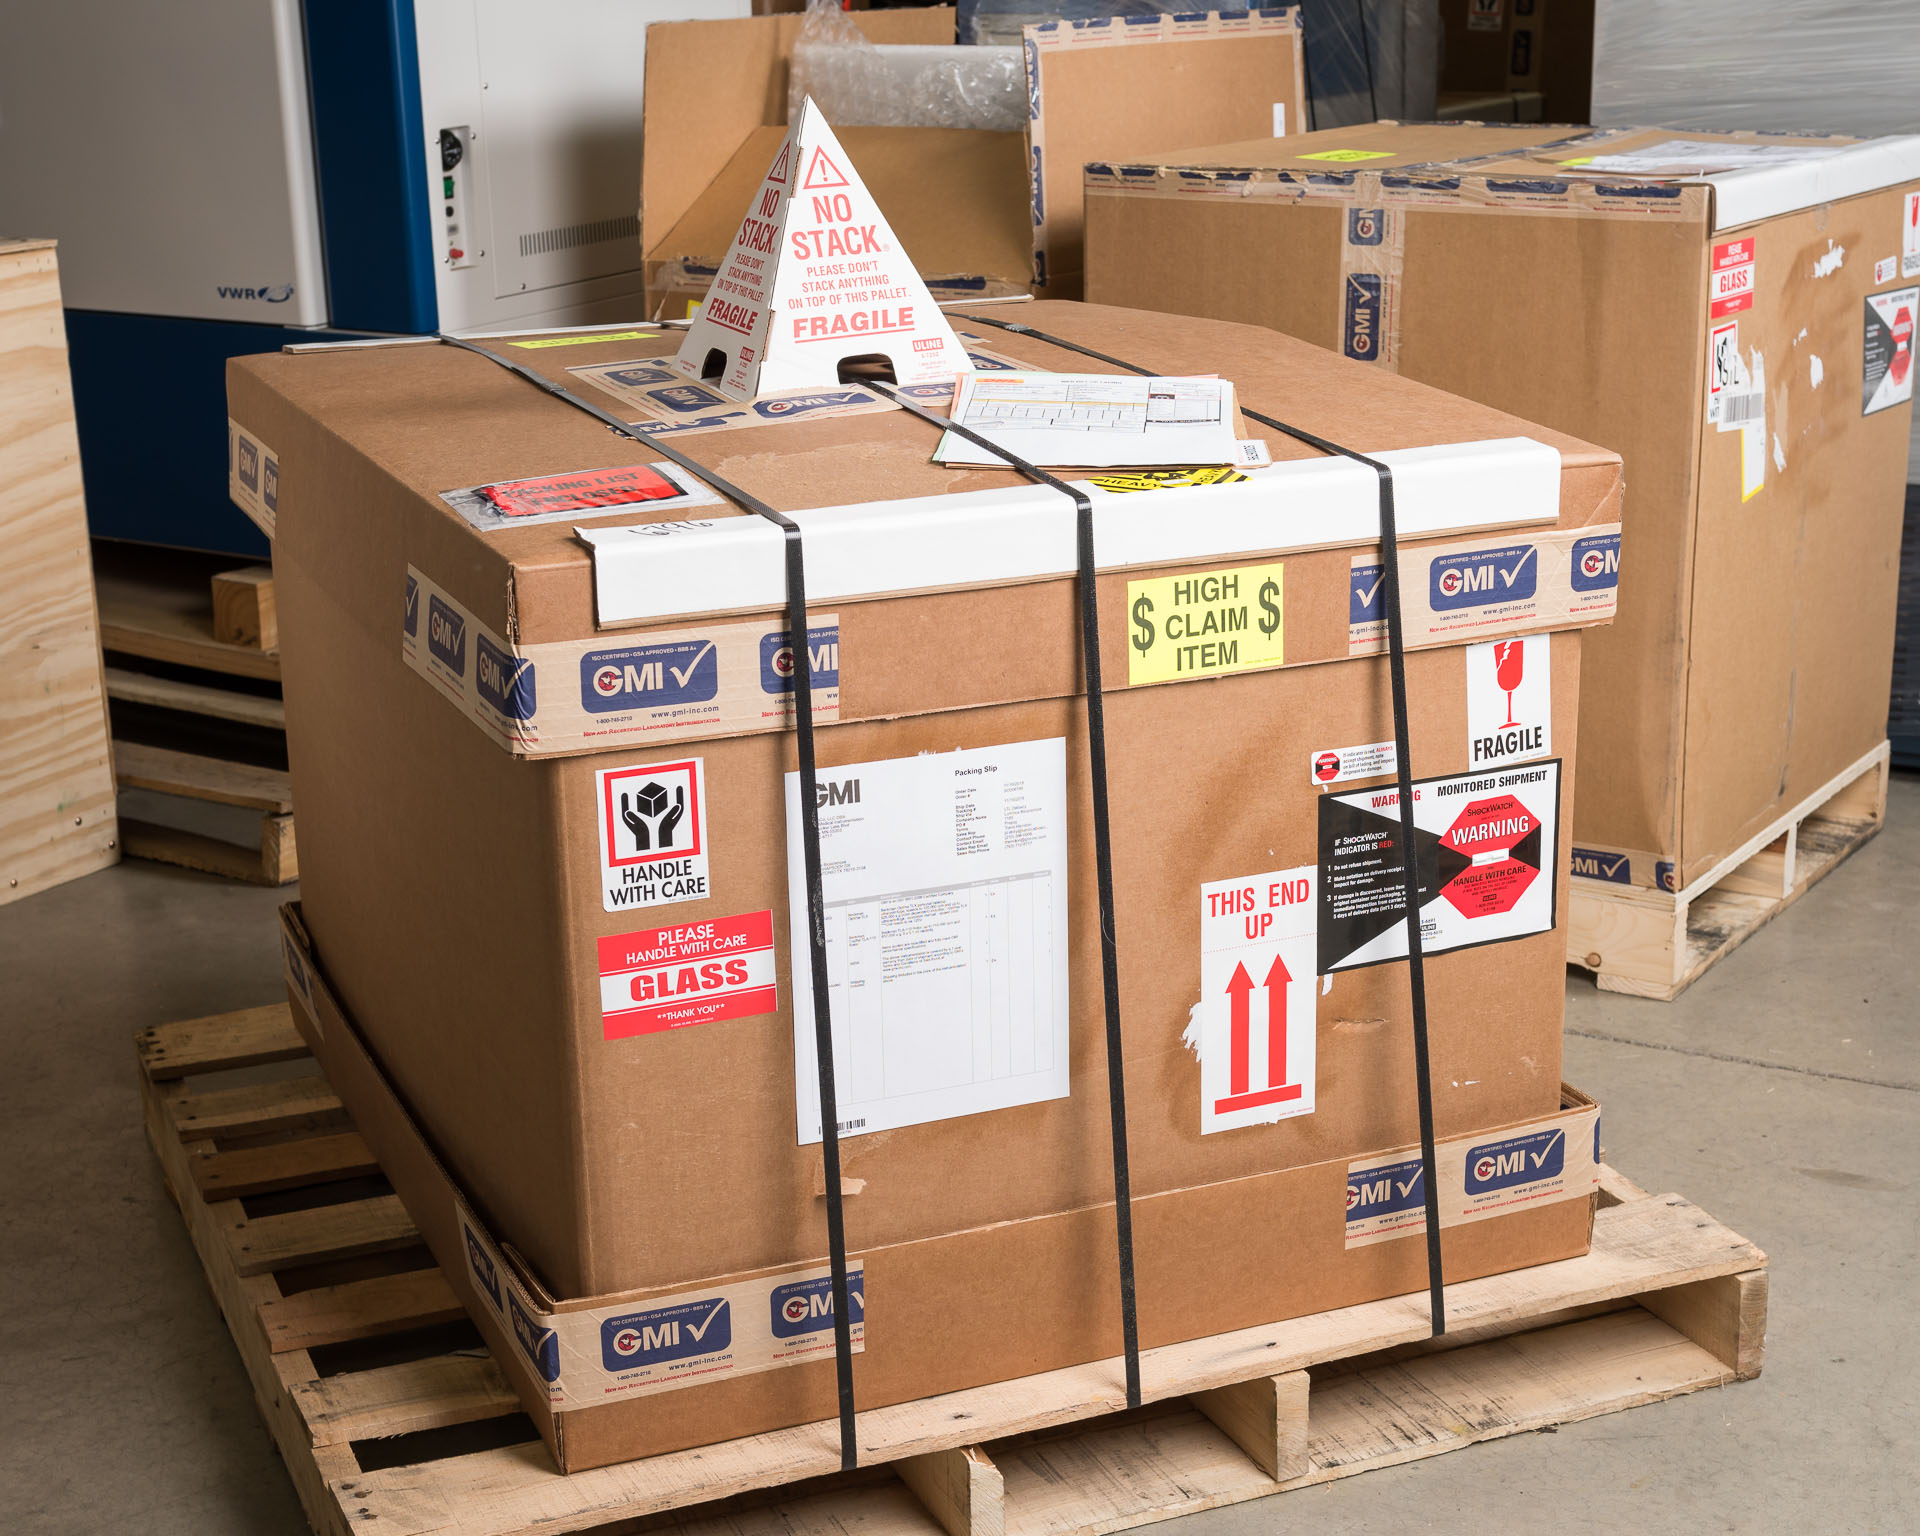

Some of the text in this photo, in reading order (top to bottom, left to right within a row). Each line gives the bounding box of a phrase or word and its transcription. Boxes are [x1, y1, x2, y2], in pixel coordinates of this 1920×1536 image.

[759, 188, 780, 218] NO
[812, 194, 852, 224] NO
[738, 218, 778, 253] STACK
[791, 225, 882, 260] STACK
[735, 253, 751, 268] PLEASE
[807, 261, 878, 277] PLEASE DON'T
[218, 286, 256, 300] VWR
[802, 274, 889, 293] STACK ANYTHING
[1720, 270, 1747, 293] GLASS
[789, 288, 911, 309] ON TOP OF THIS PALLET.
[707, 297, 758, 331] FRAGILE
[793, 307, 914, 338] FRAGILE
[914, 339, 942, 350] ULINE
[1353, 308, 1371, 353] GMI
[767, 397, 830, 413] GMI
[594, 472, 639, 485] LIST
[1103, 478, 1160, 487] HEAVY
[1175, 575, 1238, 606] HIGH
[1439, 565, 1494, 597] GMI
[432, 611, 452, 650] GMI
[1132, 577, 1280, 658] $ CLAIM $
[602, 652, 629, 660] CERTIFIED
[1177, 640, 1238, 671] ITEM
[480, 651, 500, 694] GMI
[593, 662, 663, 696] GMI
[651, 706, 719, 718] www.gmi-inc.com
[1474, 726, 1542, 762] FRAGILE
[955, 765, 997, 776] Packing Slip
[1437, 771, 1547, 797] MONITORED SHIPMENT
[816, 779, 860, 808] GMI
[1452, 815, 1529, 846] WARNING
[1335, 844, 1370, 856] INDICATOR
[622, 859, 692, 884] HANDLE
[1453, 874, 1483, 886] HANDLE
[1485, 869, 1505, 880] WITH
[1507, 865, 1527, 876] CARE
[610, 877, 706, 906] WITH CARE
[1207, 879, 1310, 918] THIS END
[658, 924, 714, 946] PLEASE
[1245, 913, 1273, 940] UP
[626, 934, 747, 964] HANDLE WITH CARE
[629, 958, 748, 1002] GLASS
[1474, 1150, 1525, 1182] GMI
[1346, 1179, 1391, 1210] GMI
[621, 1315, 647, 1325] CERTIFIED
[663, 1308, 690, 1318] APPROVED
[613, 1321, 680, 1356] GMI
[629, 1379, 659, 1389] RECERTIFIED
[660, 1373, 691, 1383] LABORATORY
[691, 1364, 734, 1376] INSTRUMENTATION
[669, 1354, 733, 1371] www.gmi-inc.com
